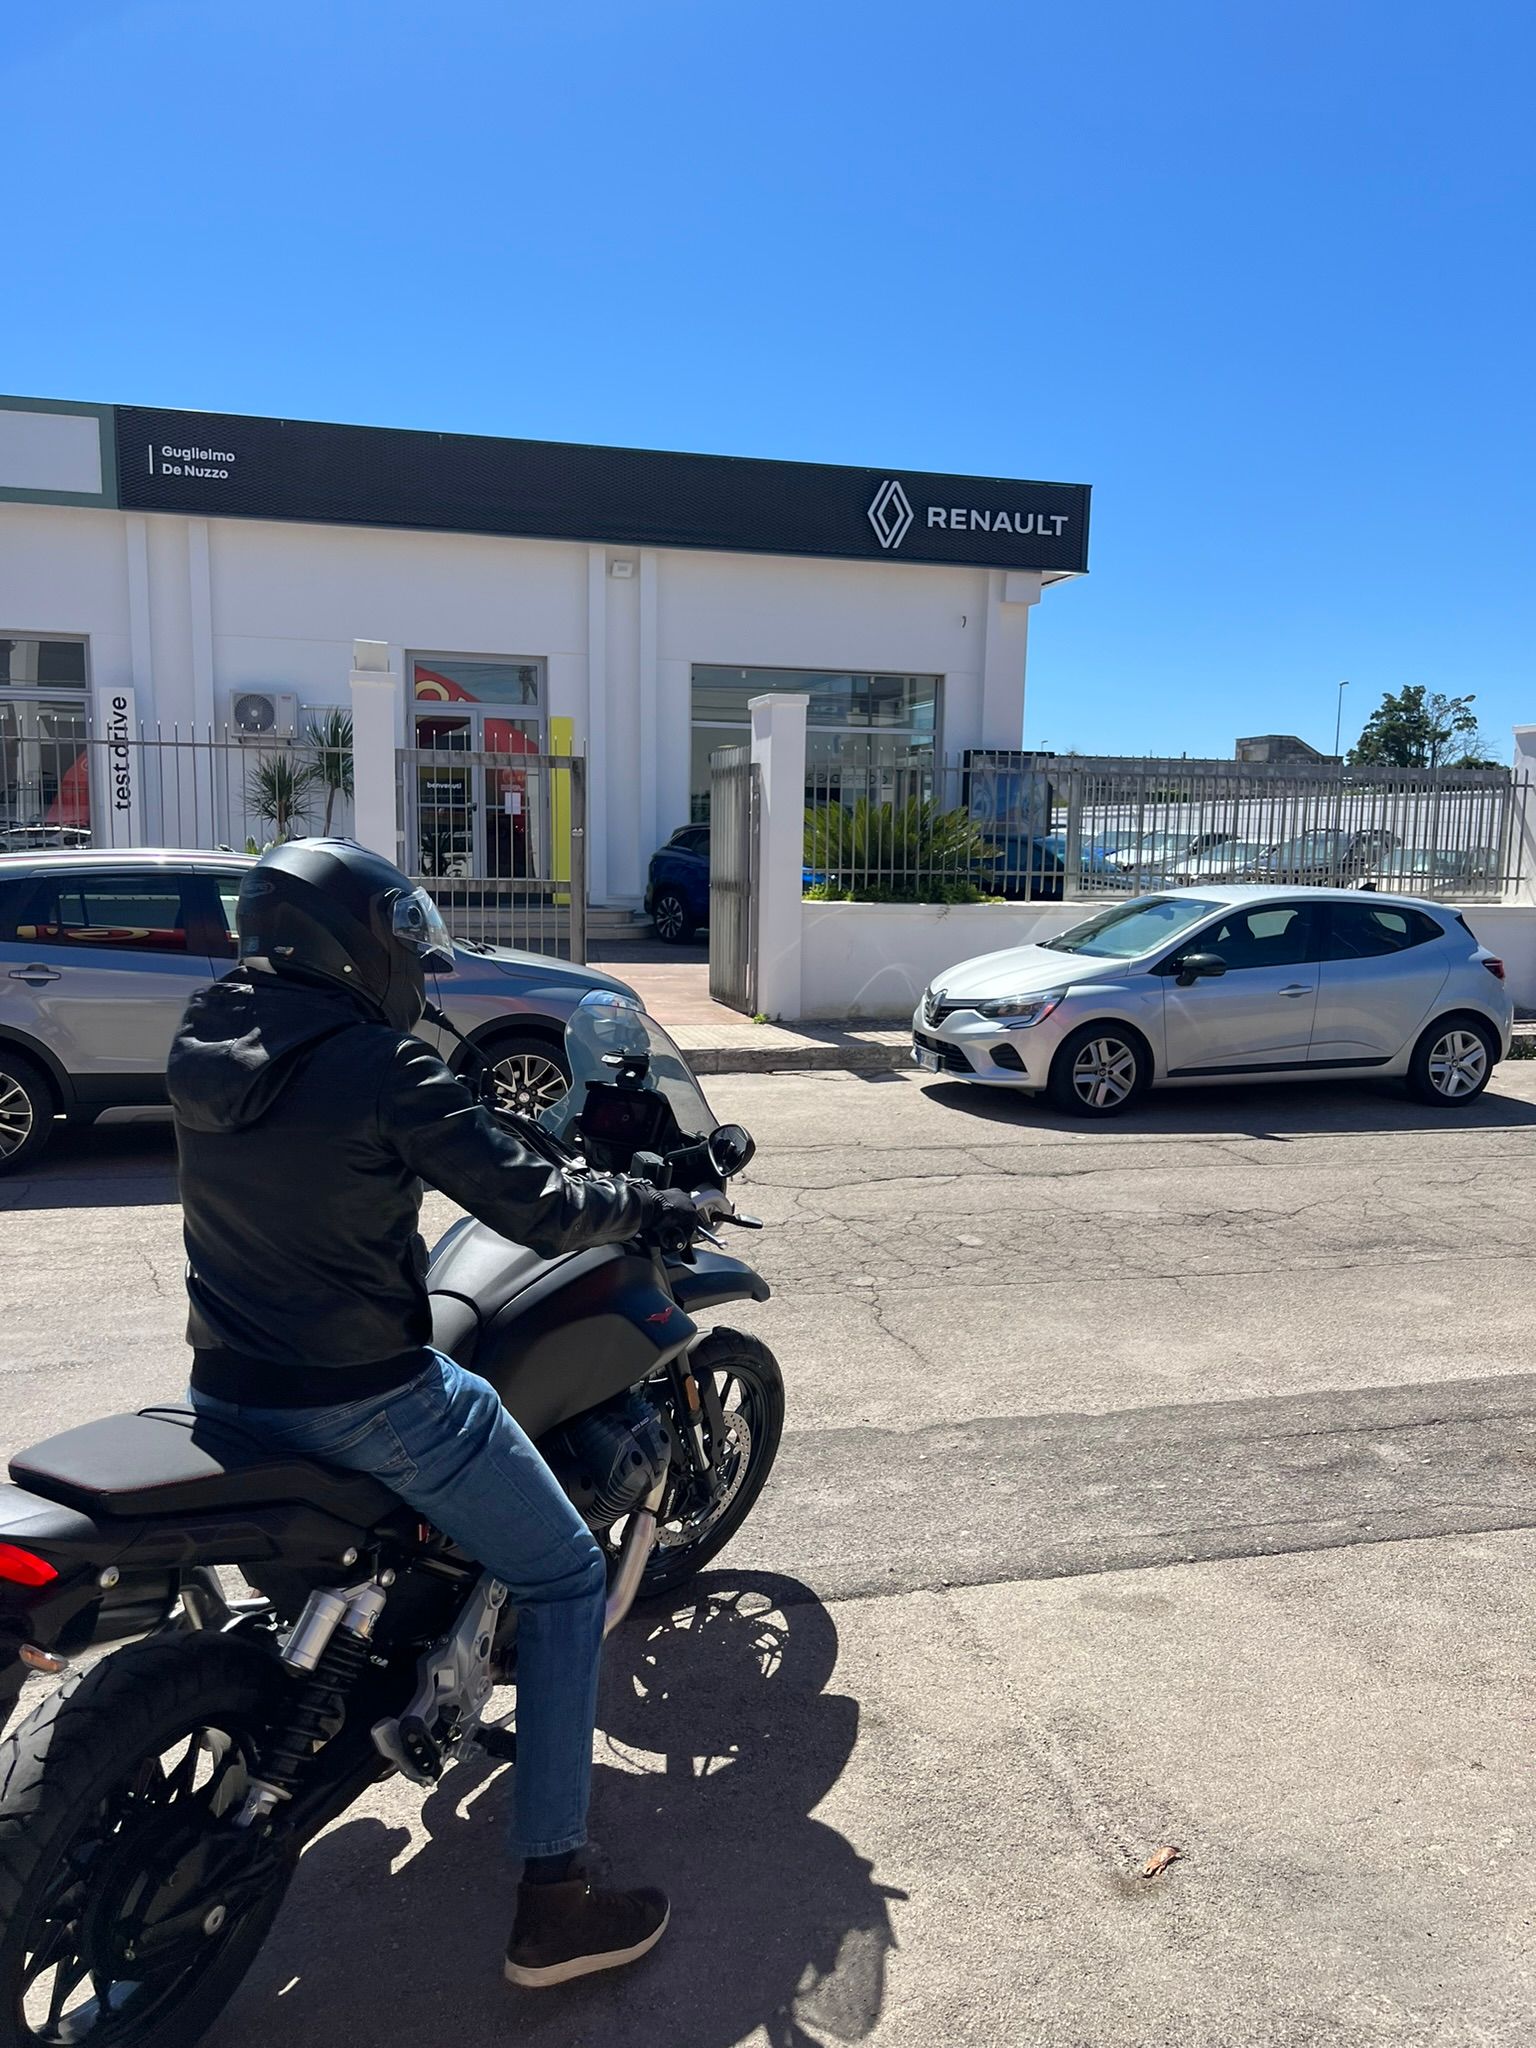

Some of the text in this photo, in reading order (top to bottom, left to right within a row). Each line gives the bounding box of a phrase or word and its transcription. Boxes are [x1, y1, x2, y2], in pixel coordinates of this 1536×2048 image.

[161, 445, 236, 463] Guglielmo
[162, 463, 229, 480] De Nuzzo
[927, 506, 1069, 537] RENAULT
[109, 697, 131, 811] test drive
